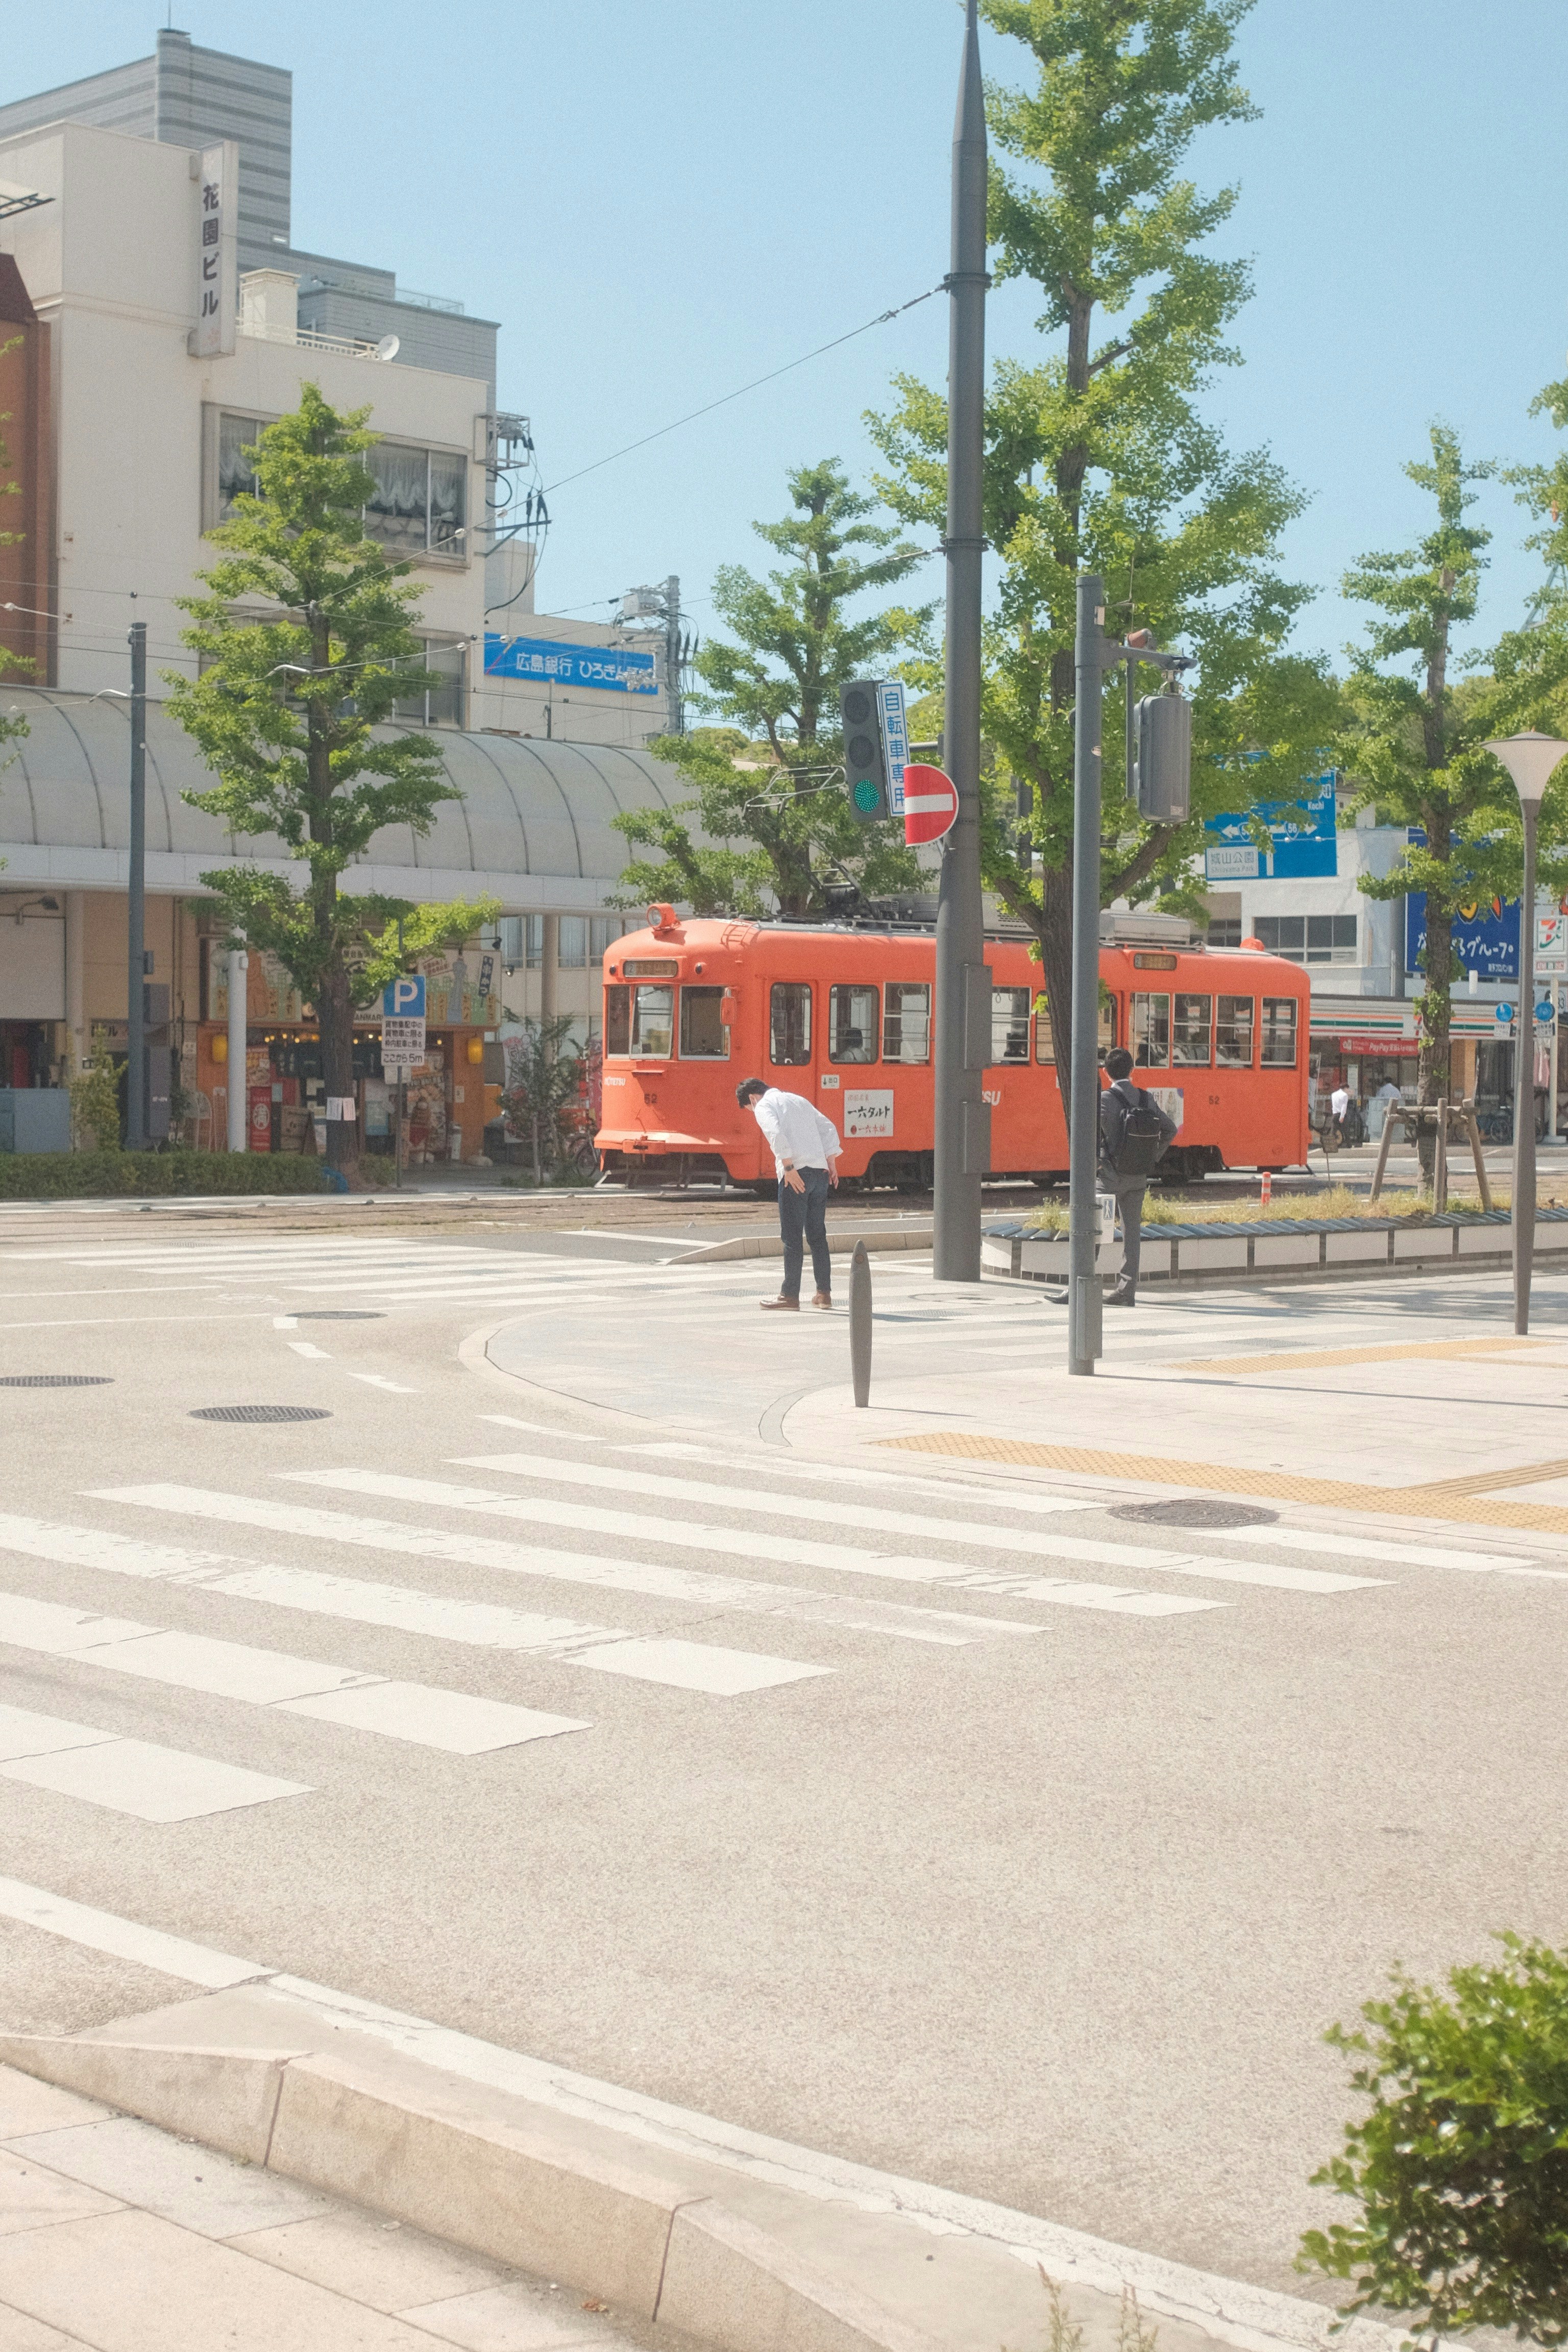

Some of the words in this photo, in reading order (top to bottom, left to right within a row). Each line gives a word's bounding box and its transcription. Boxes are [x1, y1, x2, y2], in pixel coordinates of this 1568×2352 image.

[202, 183, 219, 317] 花園ビル
[516, 652, 573, 676] 広島銀行
[579, 660, 654, 685] ひろぎん
[885, 691, 905, 807] 自転車専用
[1308, 800, 1325, 811] Kochi
[1211, 851, 1254, 864] 城山公園
[394, 979, 419, 1013] P
[354, 1013, 383, 1021] ANMAR
[644, 1093, 657, 1104] 52
[1209, 1095, 1220, 1105] 52
[847, 1105, 890, 1119] 一六タルト
